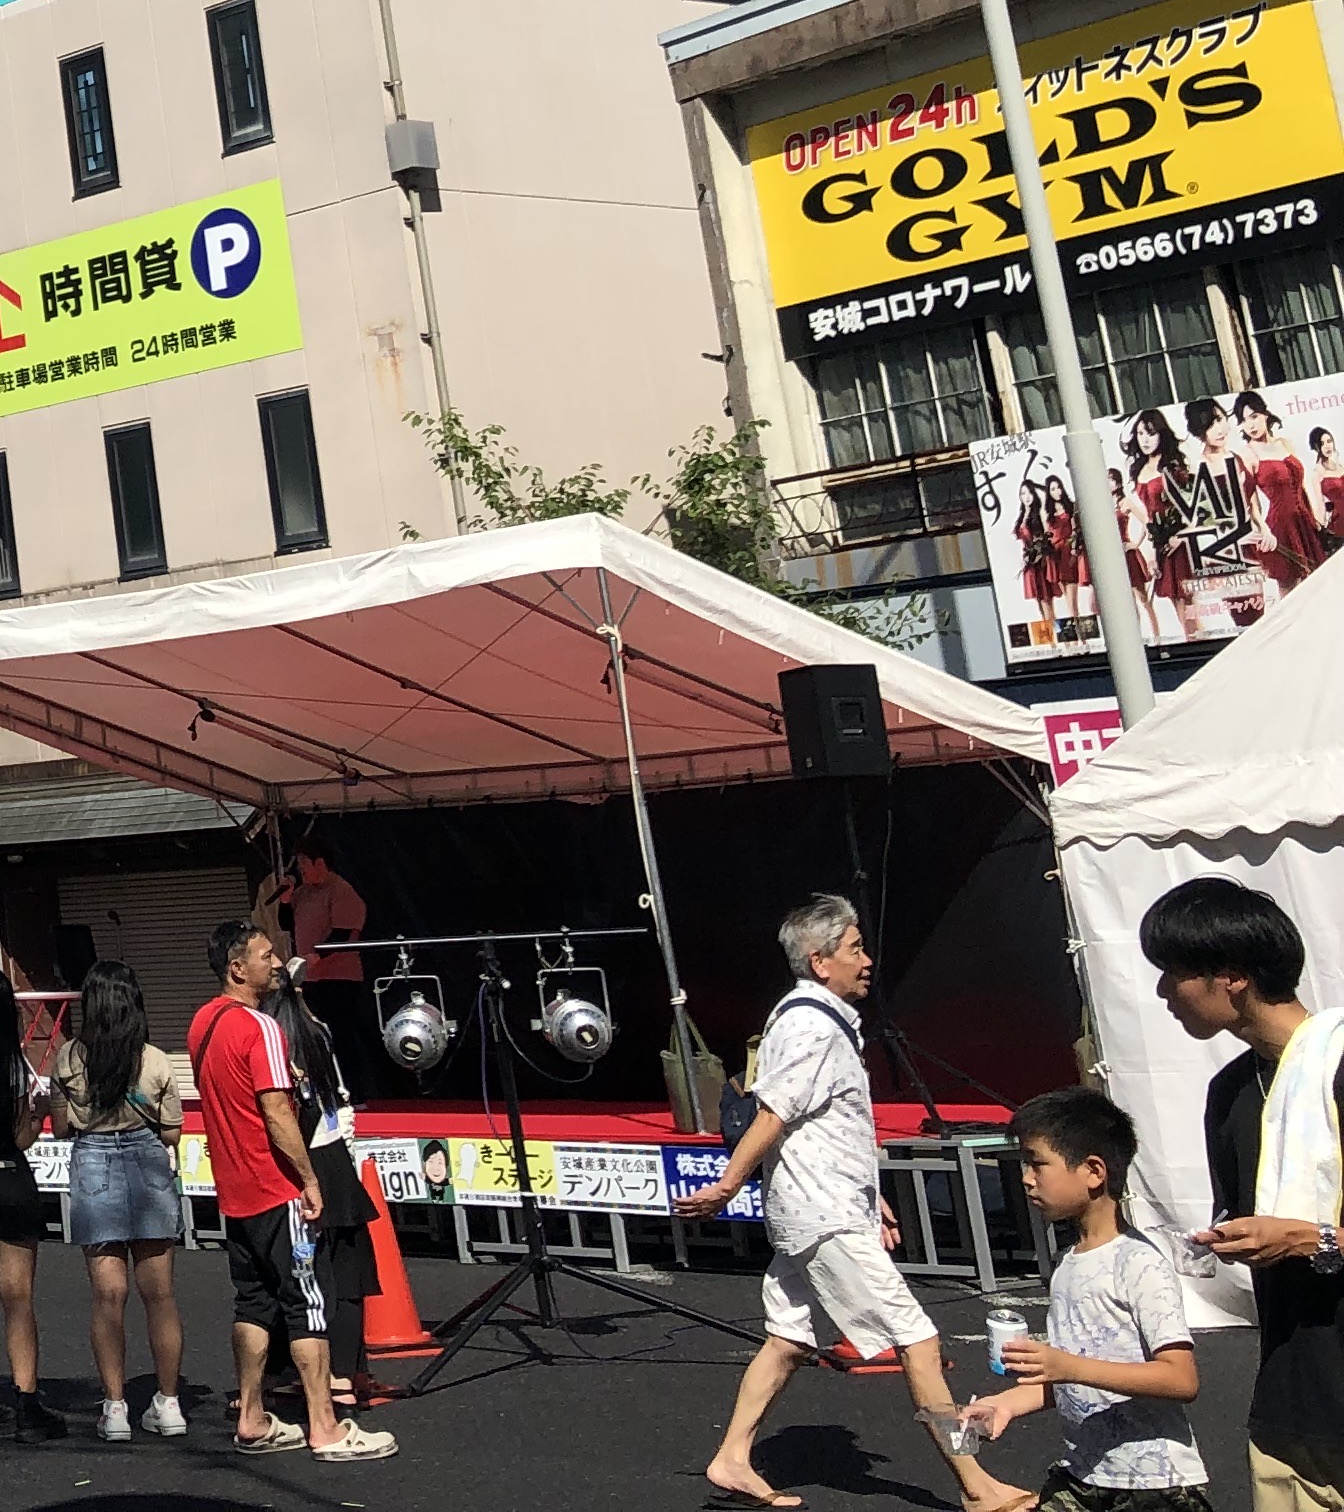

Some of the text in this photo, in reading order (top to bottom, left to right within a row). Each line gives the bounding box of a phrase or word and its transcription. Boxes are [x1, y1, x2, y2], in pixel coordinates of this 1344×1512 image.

[994, 2, 1268, 113] ィットネスクラブ
[784, 84, 978, 173] OPEN 24h
[802, 60, 1263, 223] GOLD'S
[1098, 198, 1318, 272] 0566(74)7373
[39, 223, 250, 323] 時間貸 P
[808, 264, 1036, 342] 安城コロナワール
[130, 318, 238, 364] 24時間営業
[29, 1160, 71, 1180] デンパ
[479, 1144, 540, 1164] きーー
[560, 1156, 658, 1175] 安城産業文化公園
[676, 1153, 731, 1178] 株式会
[381, 1168, 420, 1199] ign
[562, 1174, 659, 1201] デンパーク
